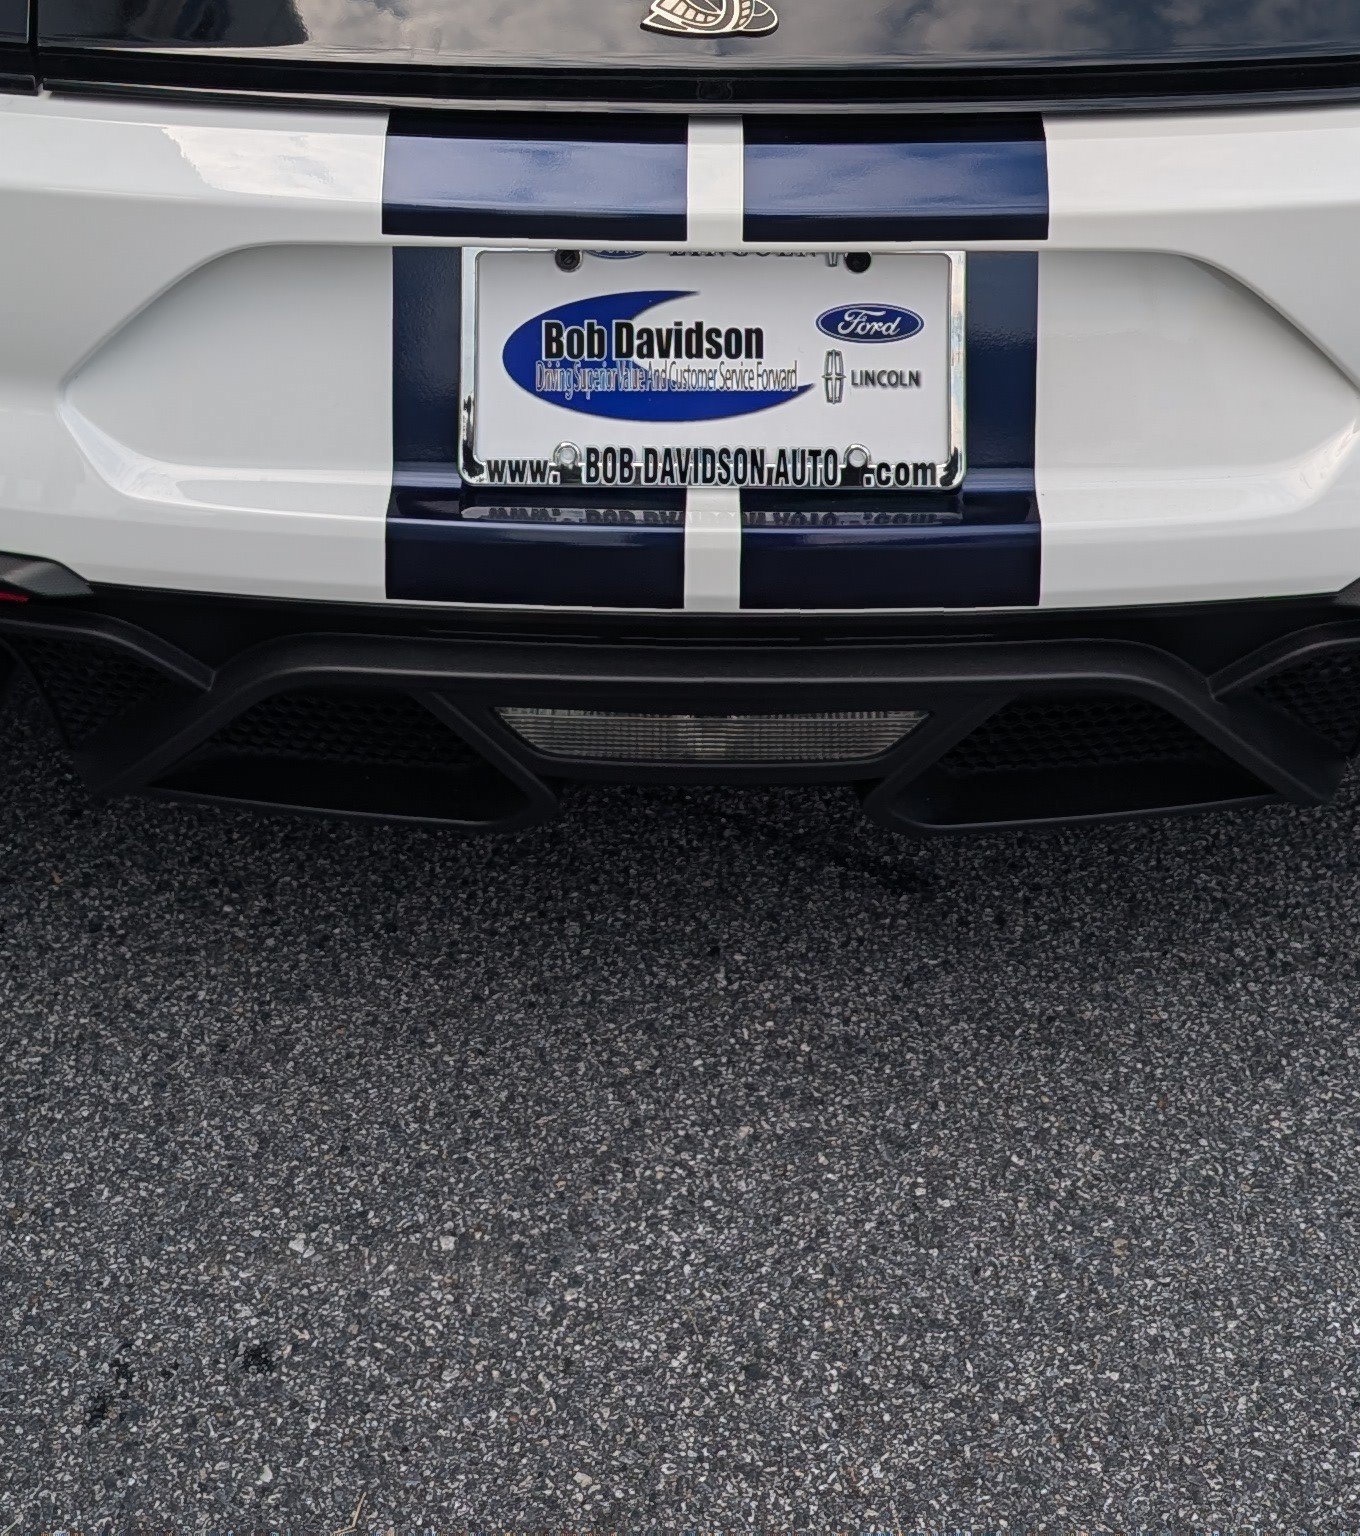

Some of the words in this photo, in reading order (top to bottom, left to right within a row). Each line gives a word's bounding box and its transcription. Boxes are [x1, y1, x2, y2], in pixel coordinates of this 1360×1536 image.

[543, 320, 607, 360] Bob
[613, 320, 765, 360] Davidson
[837, 308, 902, 336] Ford
[536, 361, 573, 400] Driving
[573, 361, 617, 400] Superior
[617, 360, 646, 391] Value
[647, 361, 668, 391] And
[669, 361, 718, 391] Customer
[719, 360, 755, 391] Service
[756, 360, 798, 391] Forward
[850, 369, 921, 388] LINCOLN
[585, 446, 634, 485] BOB
[643, 447, 765, 486] DAVIDSON
[774, 447, 840, 486] AUTO
